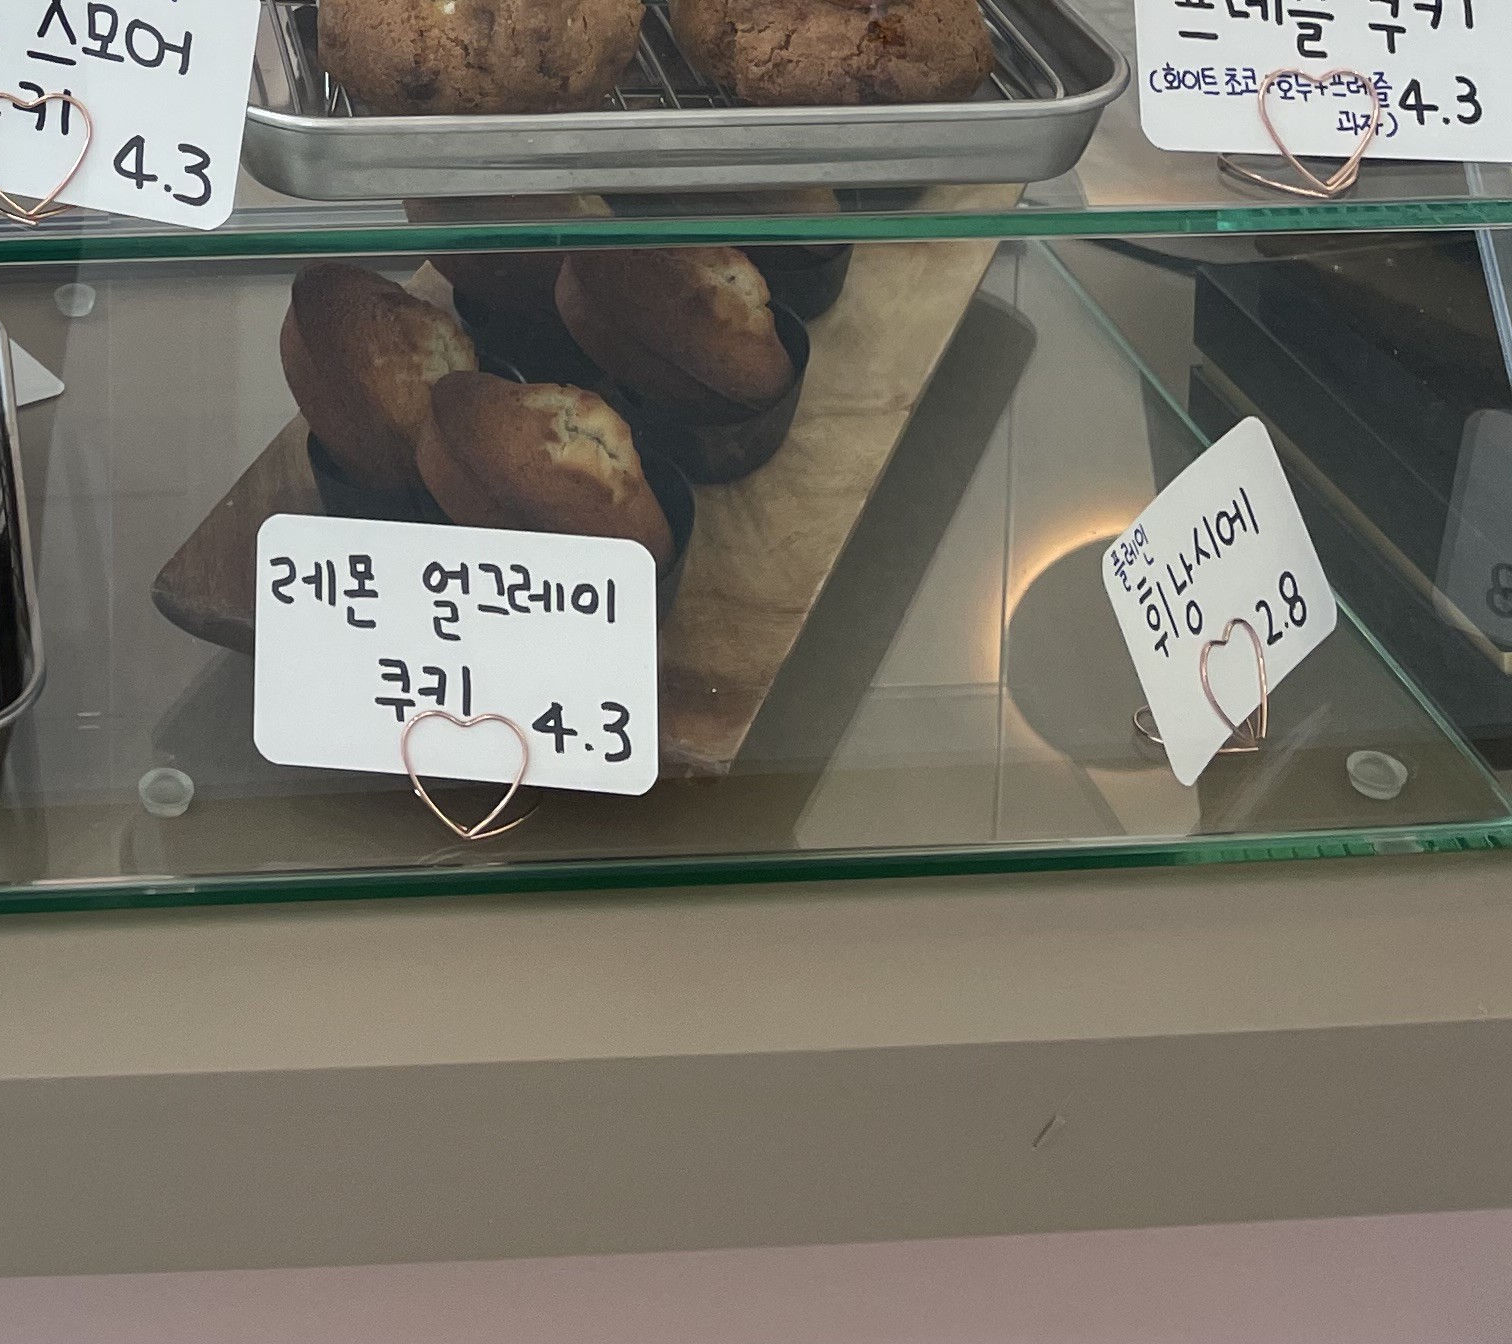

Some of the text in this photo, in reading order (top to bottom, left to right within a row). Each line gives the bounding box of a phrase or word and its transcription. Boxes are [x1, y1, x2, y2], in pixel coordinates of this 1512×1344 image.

[1150, 62, 1220, 95] (화이트
[1398, 77, 1483, 126] 4.3
[1336, 111, 1398, 138] 과자)
[114, 135, 211, 206] 4.3
[1111, 524, 1154, 593] 플레인
[1137, 487, 1259, 658] 휘낭시에
[270, 555, 615, 641] 레몬 얼그레이
[1255, 571, 1307, 646] 2.8
[375, 659, 471, 722] 쿠키
[532, 702, 631, 762] 4.3
